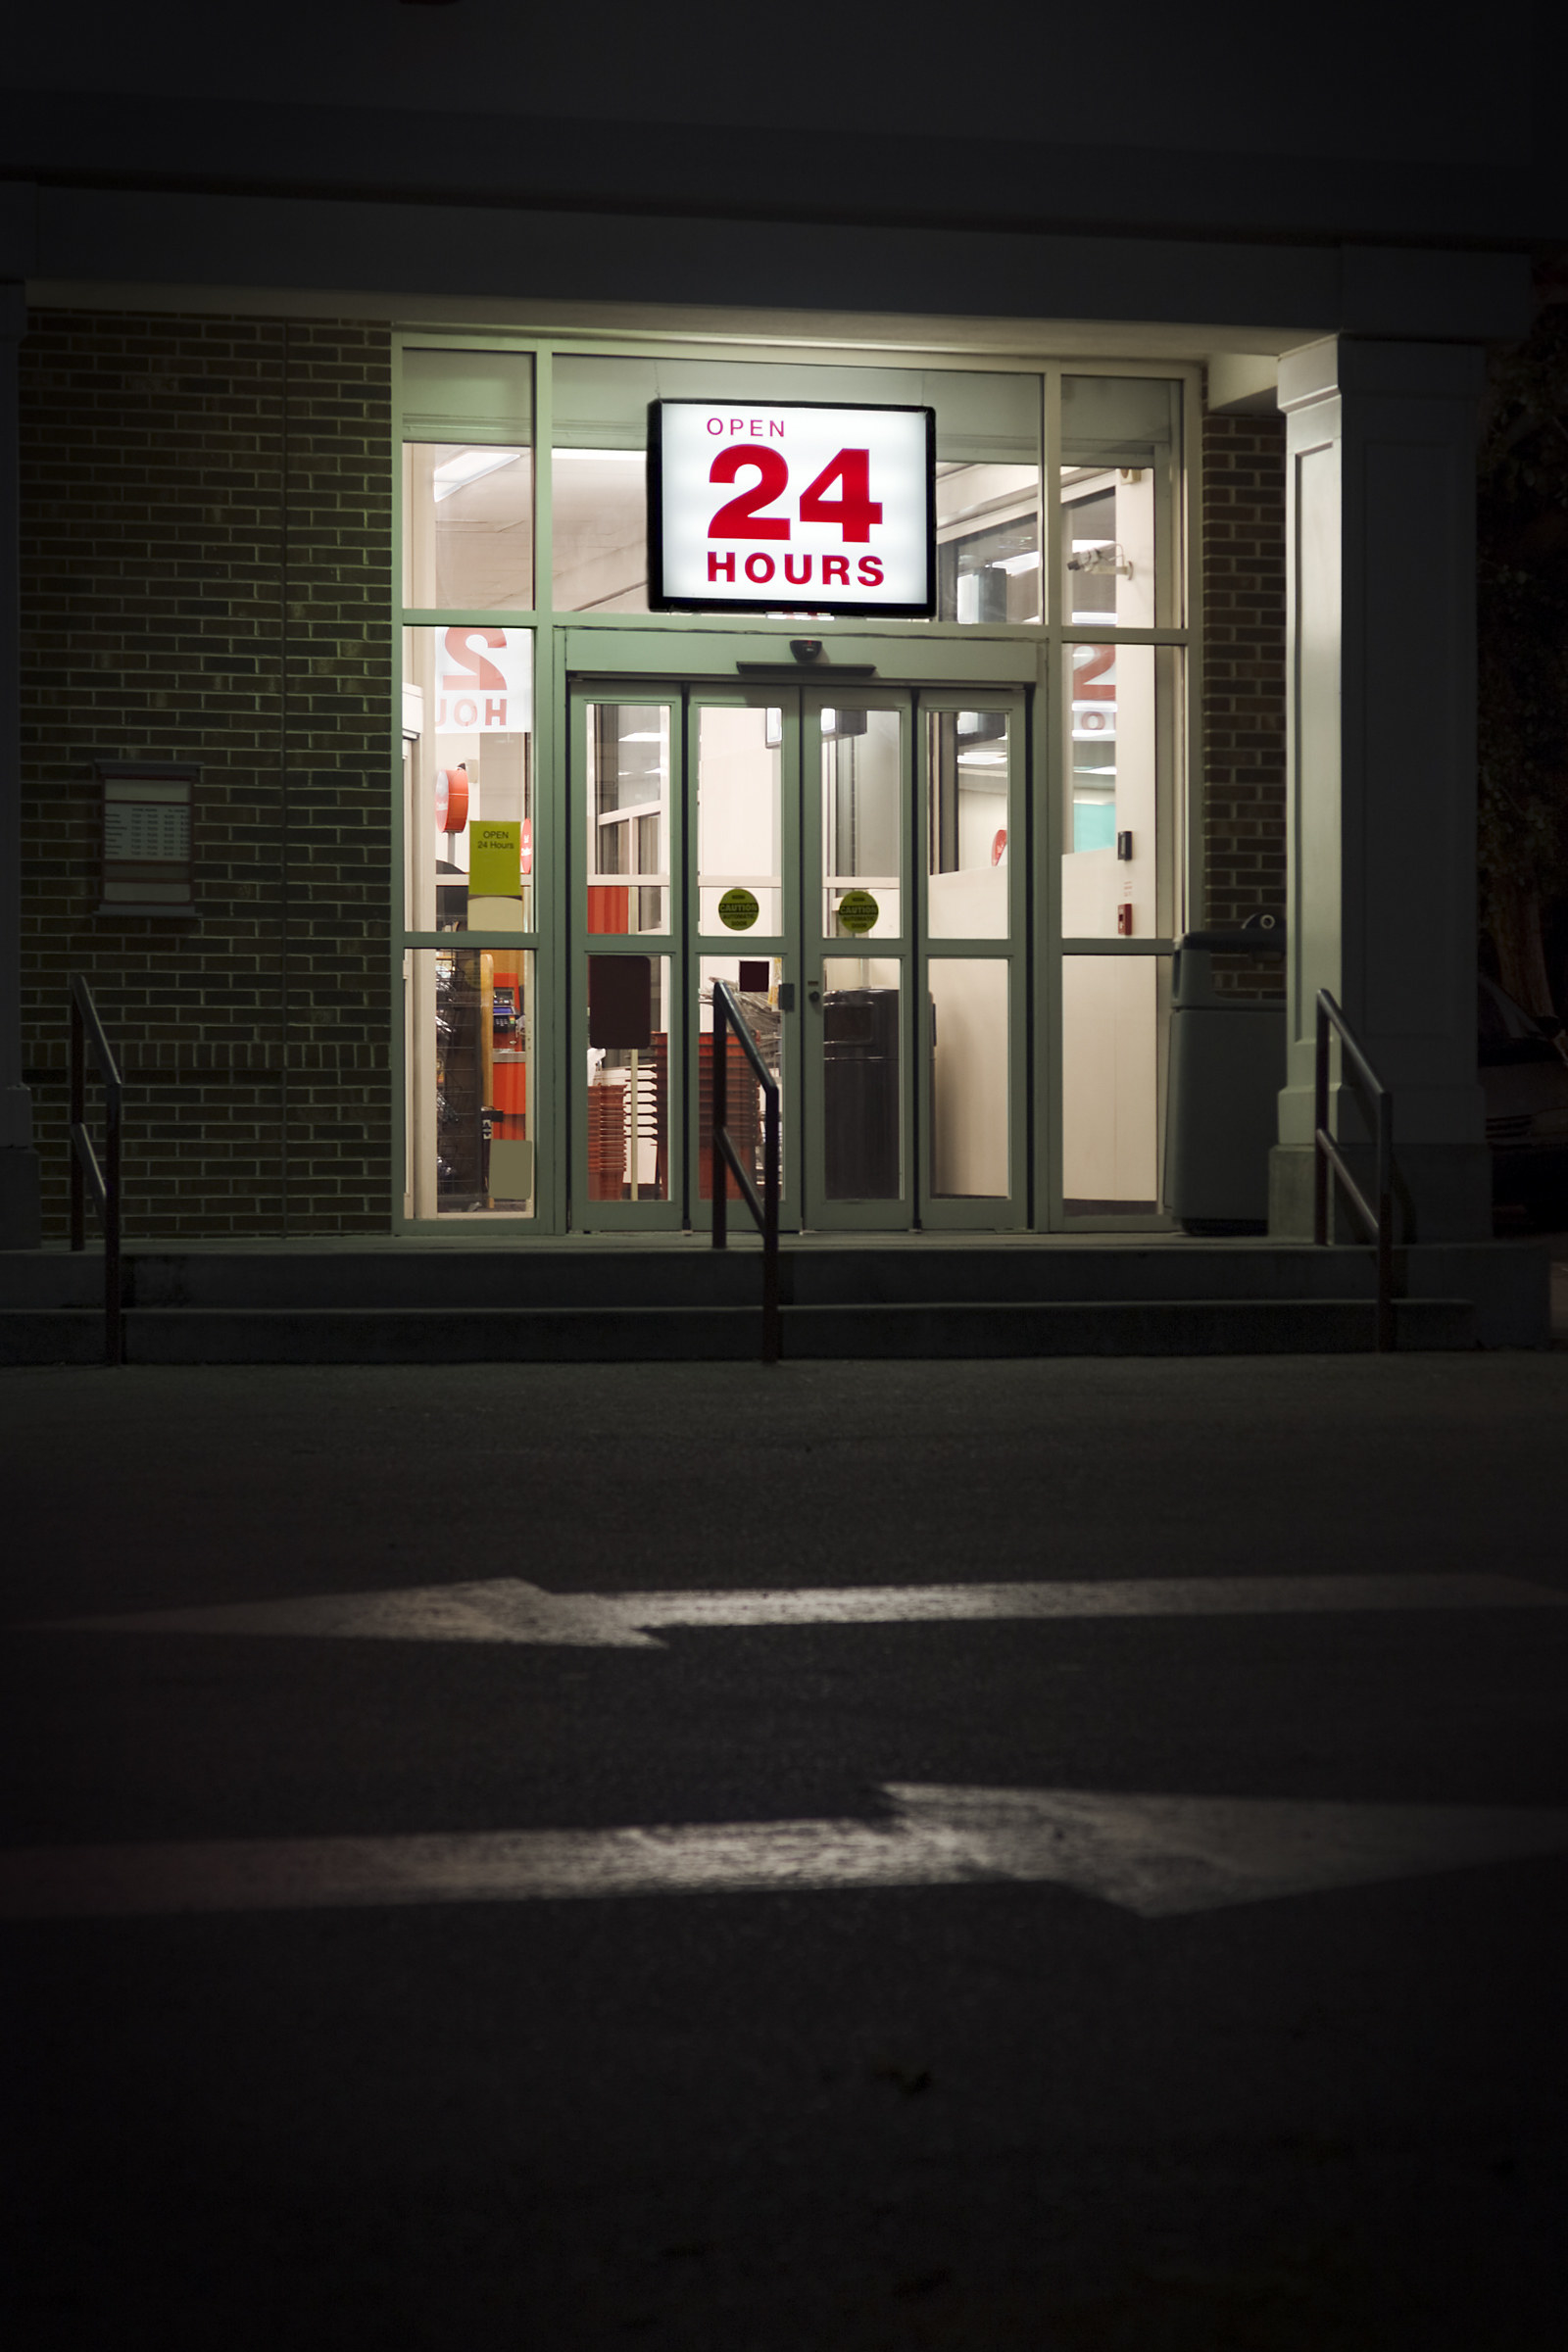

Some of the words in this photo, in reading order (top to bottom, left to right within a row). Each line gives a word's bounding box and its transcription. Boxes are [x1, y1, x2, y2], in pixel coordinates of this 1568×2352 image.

[707, 417, 784, 437] OPEN
[708, 444, 883, 543] 24
[708, 552, 884, 587] HOURS
[483, 830, 510, 839] OPEN
[477, 840, 488, 849] 24
[490, 841, 514, 850] Hours
[719, 904, 758, 912] CAUTION
